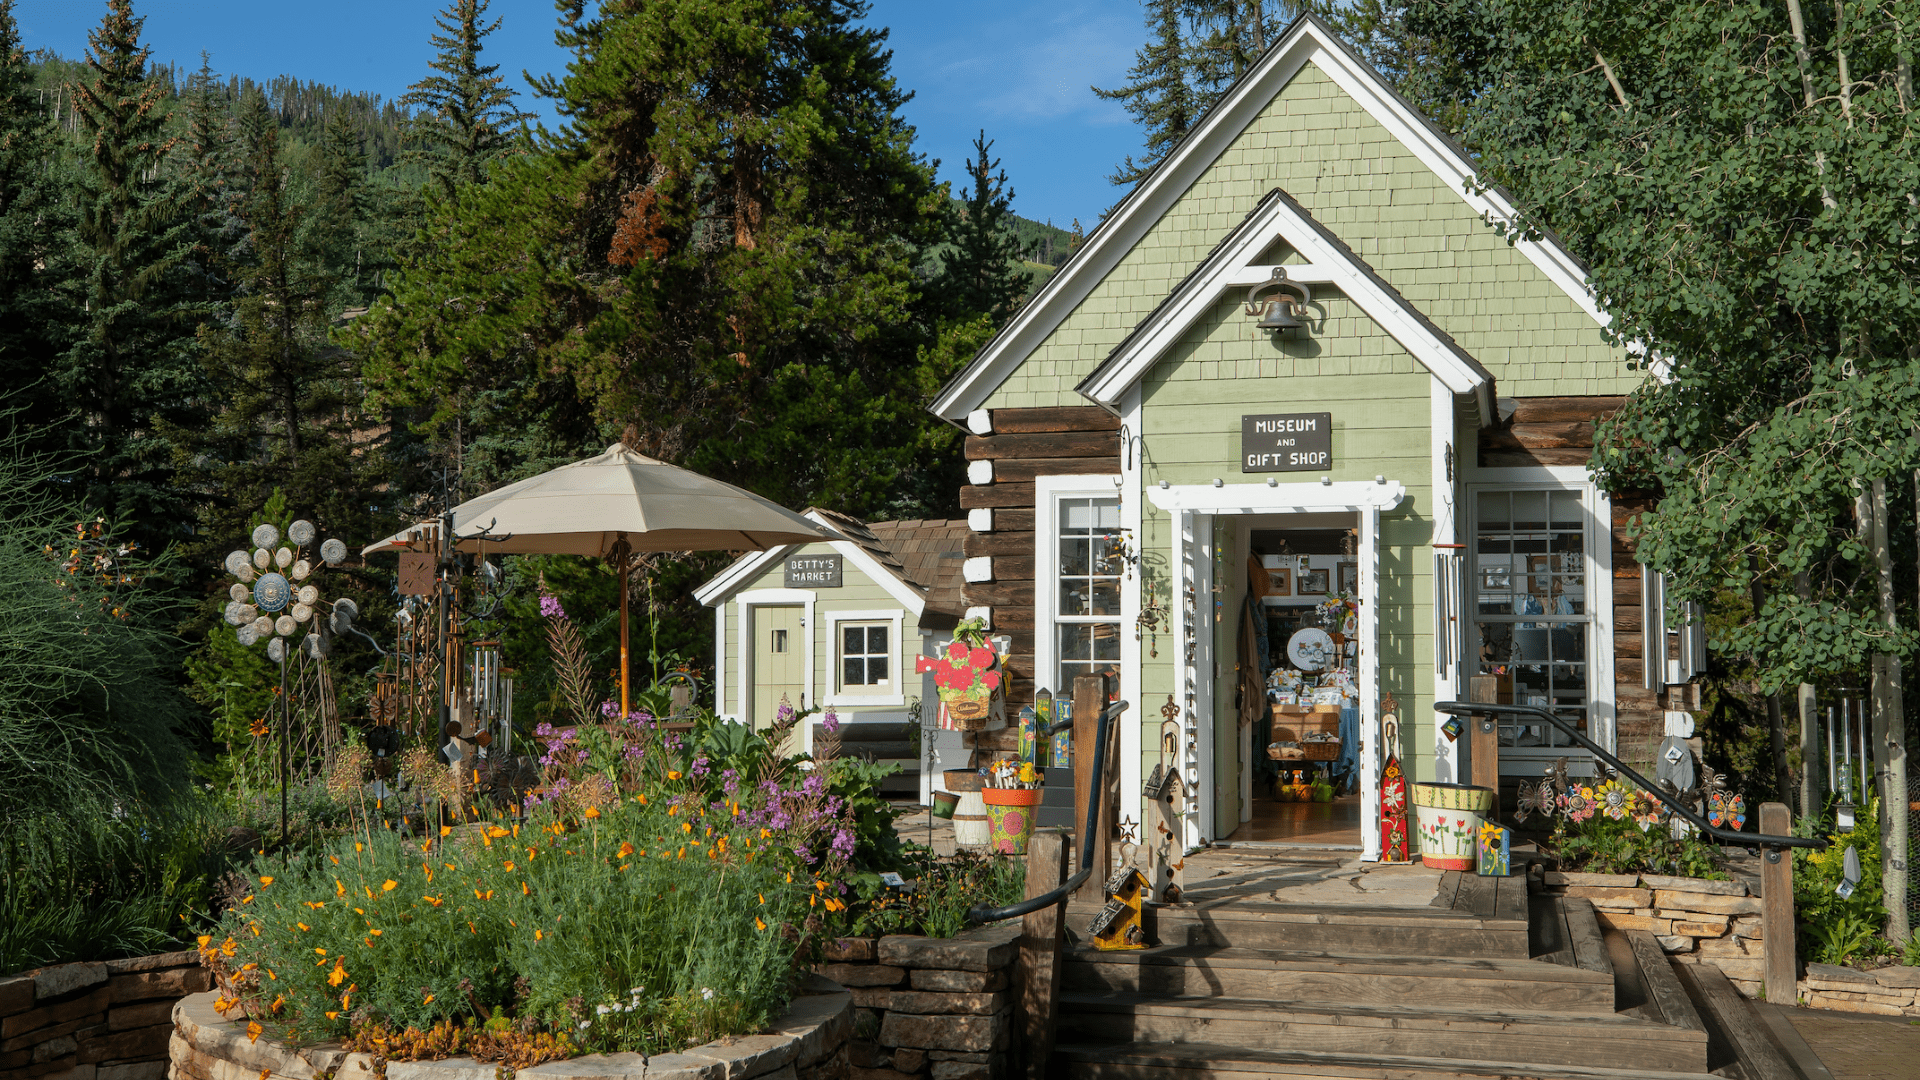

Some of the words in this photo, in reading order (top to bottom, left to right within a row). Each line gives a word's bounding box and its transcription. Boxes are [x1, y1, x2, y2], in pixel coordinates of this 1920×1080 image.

[1256, 419, 1316, 433] MUSEUM
[1276, 438, 1296, 447] AND
[1247, 453, 1281, 466] GIFT
[1290, 451, 1327, 465] SHOP
[791, 559, 835, 570] BETTY'S
[792, 571, 833, 581] MARKET
